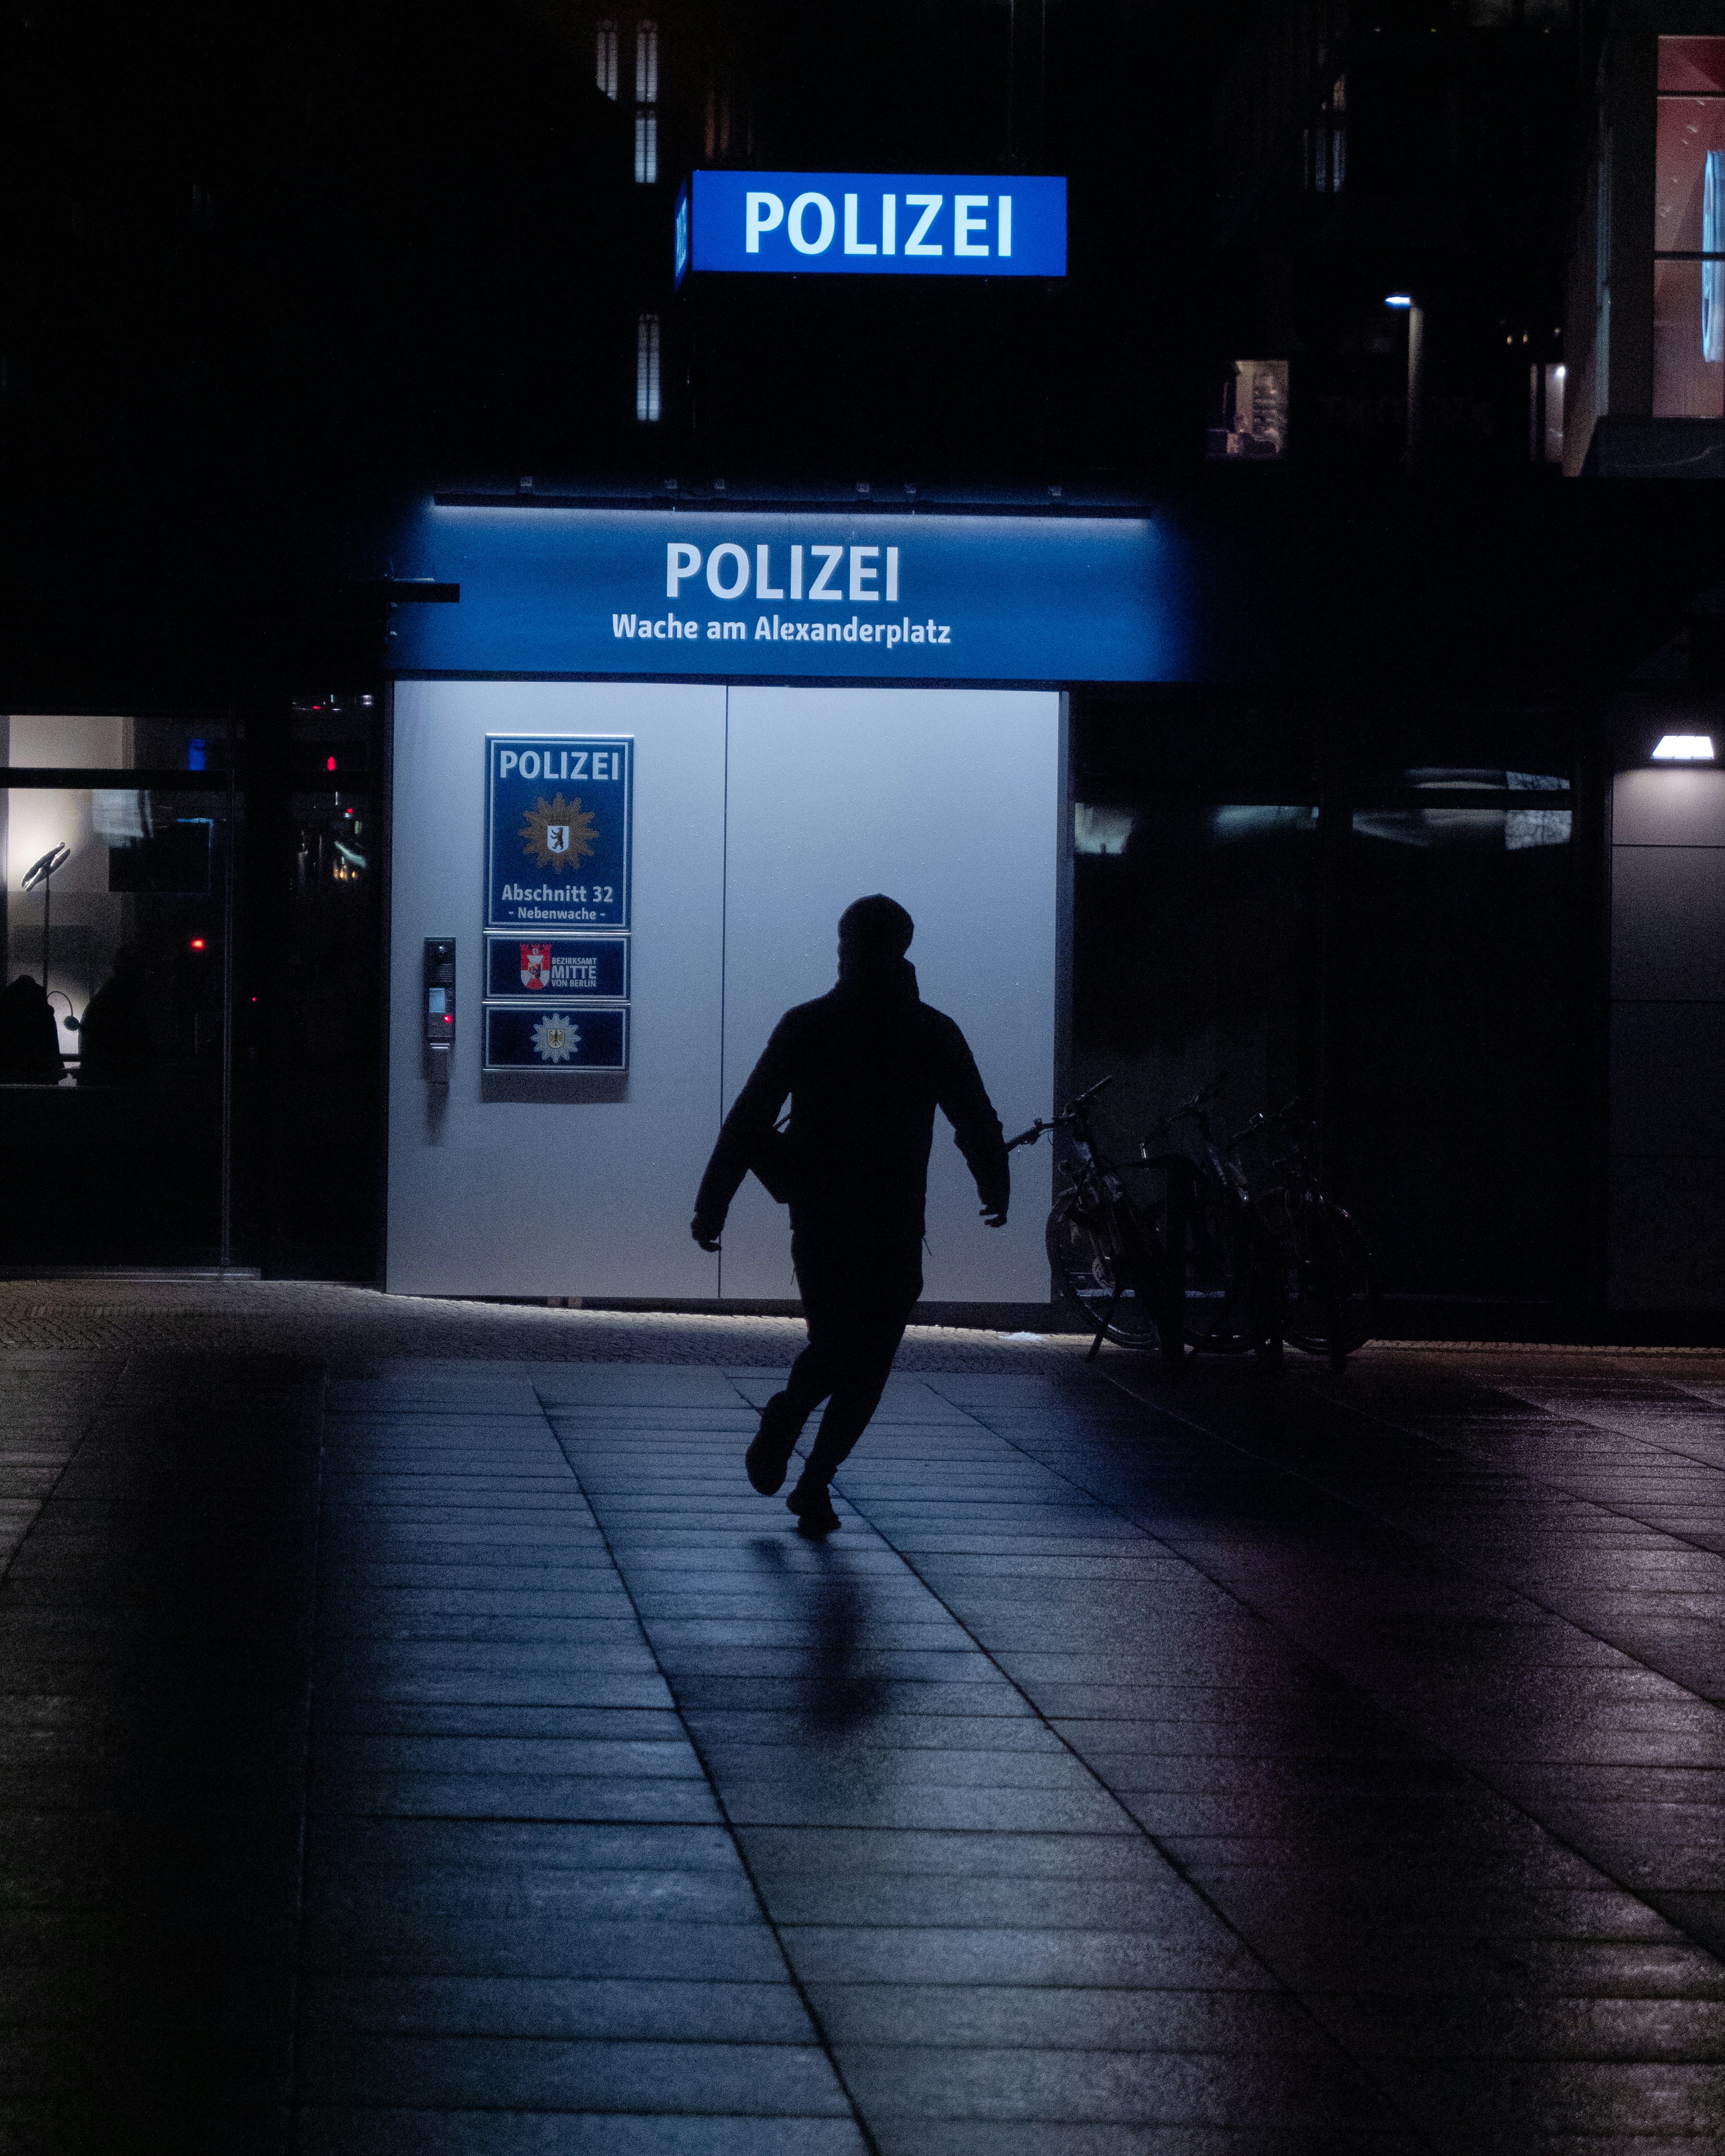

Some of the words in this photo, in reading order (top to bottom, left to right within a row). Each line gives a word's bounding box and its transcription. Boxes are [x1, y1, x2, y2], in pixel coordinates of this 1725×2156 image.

[746, 192, 1011, 256] POLIZEI
[667, 543, 899, 601] POLIZEI
[613, 613, 698, 639] Wache
[707, 622, 746, 639] am
[755, 615, 951, 648] Alexanderplatz
[500, 751, 619, 780] POLIZEI
[502, 883, 586, 902] Abschnitt
[593, 886, 613, 902] 32
[519, 907, 596, 920] Nebenwache
[552, 966, 596, 979] MITTE
